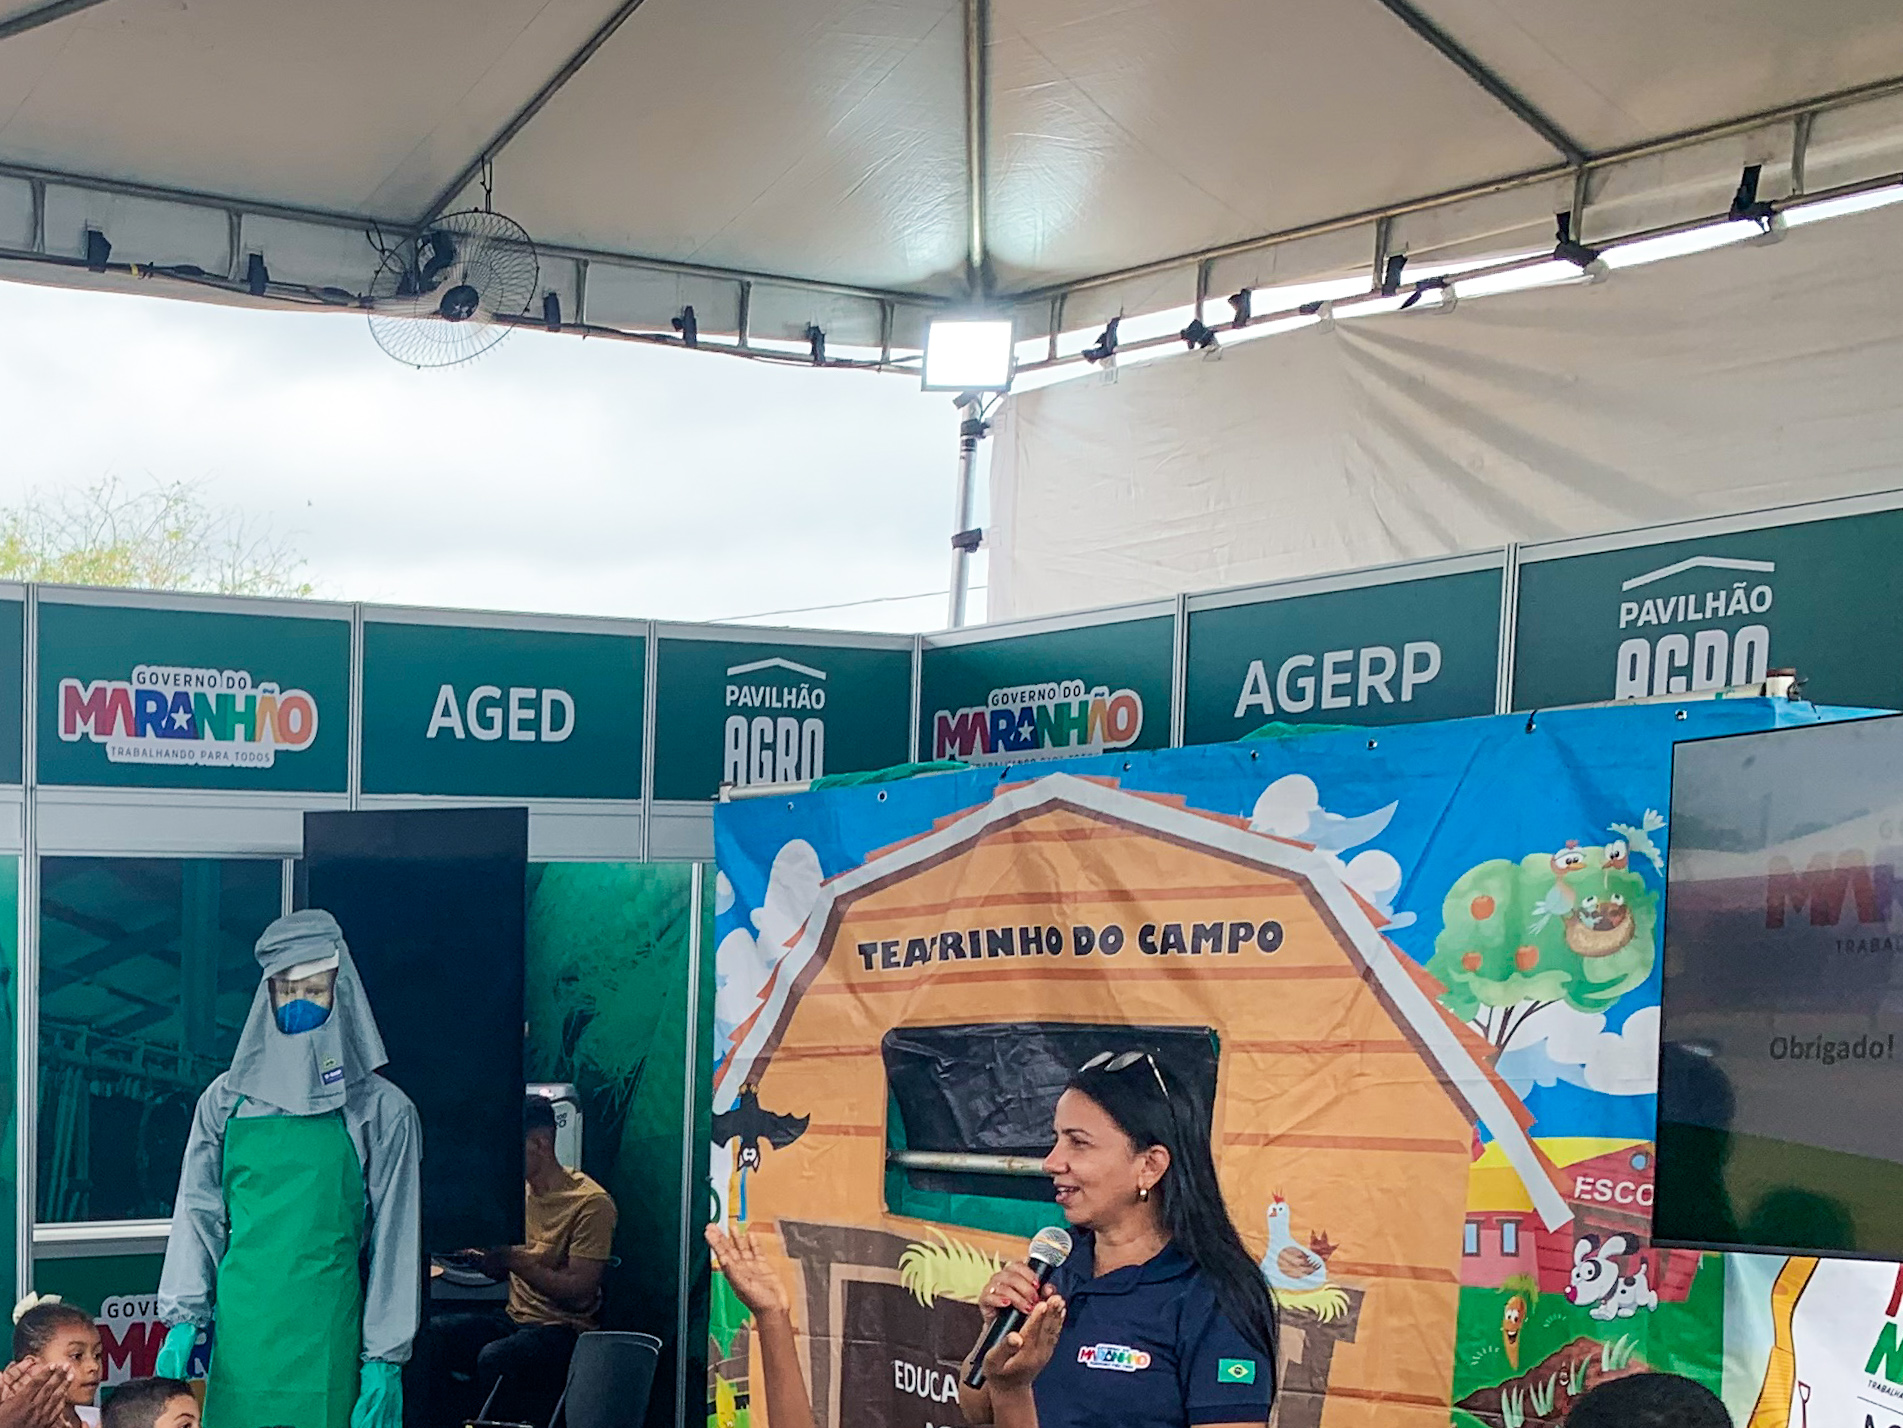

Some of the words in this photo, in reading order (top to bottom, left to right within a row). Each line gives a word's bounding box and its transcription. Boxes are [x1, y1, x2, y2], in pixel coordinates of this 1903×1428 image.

[1619, 582, 1773, 629] PAVILHÃO
[136, 671, 217, 689] GOVERNO
[226, 676, 247, 690] DO
[725, 684, 826, 710] PAVILHÃO
[991, 687, 1057, 707] GOVERNO
[1063, 685, 1081, 698] DO
[1233, 640, 1443, 718] AGERP
[64, 685, 313, 745] MARANHÃO
[426, 684, 576, 743] AGED
[936, 692, 1139, 759] MARANHÃO
[110, 746, 195, 760] TRABALHANDO
[200, 750, 229, 761] PARA
[234, 751, 271, 763] TODOS
[724, 715, 824, 787] AGRO
[1073, 923, 1124, 957] DO
[1137, 918, 1284, 956] CAMPO
[1768, 1033, 1895, 1066] Obrigado!
[1574, 1176, 1654, 1206] ESCO
